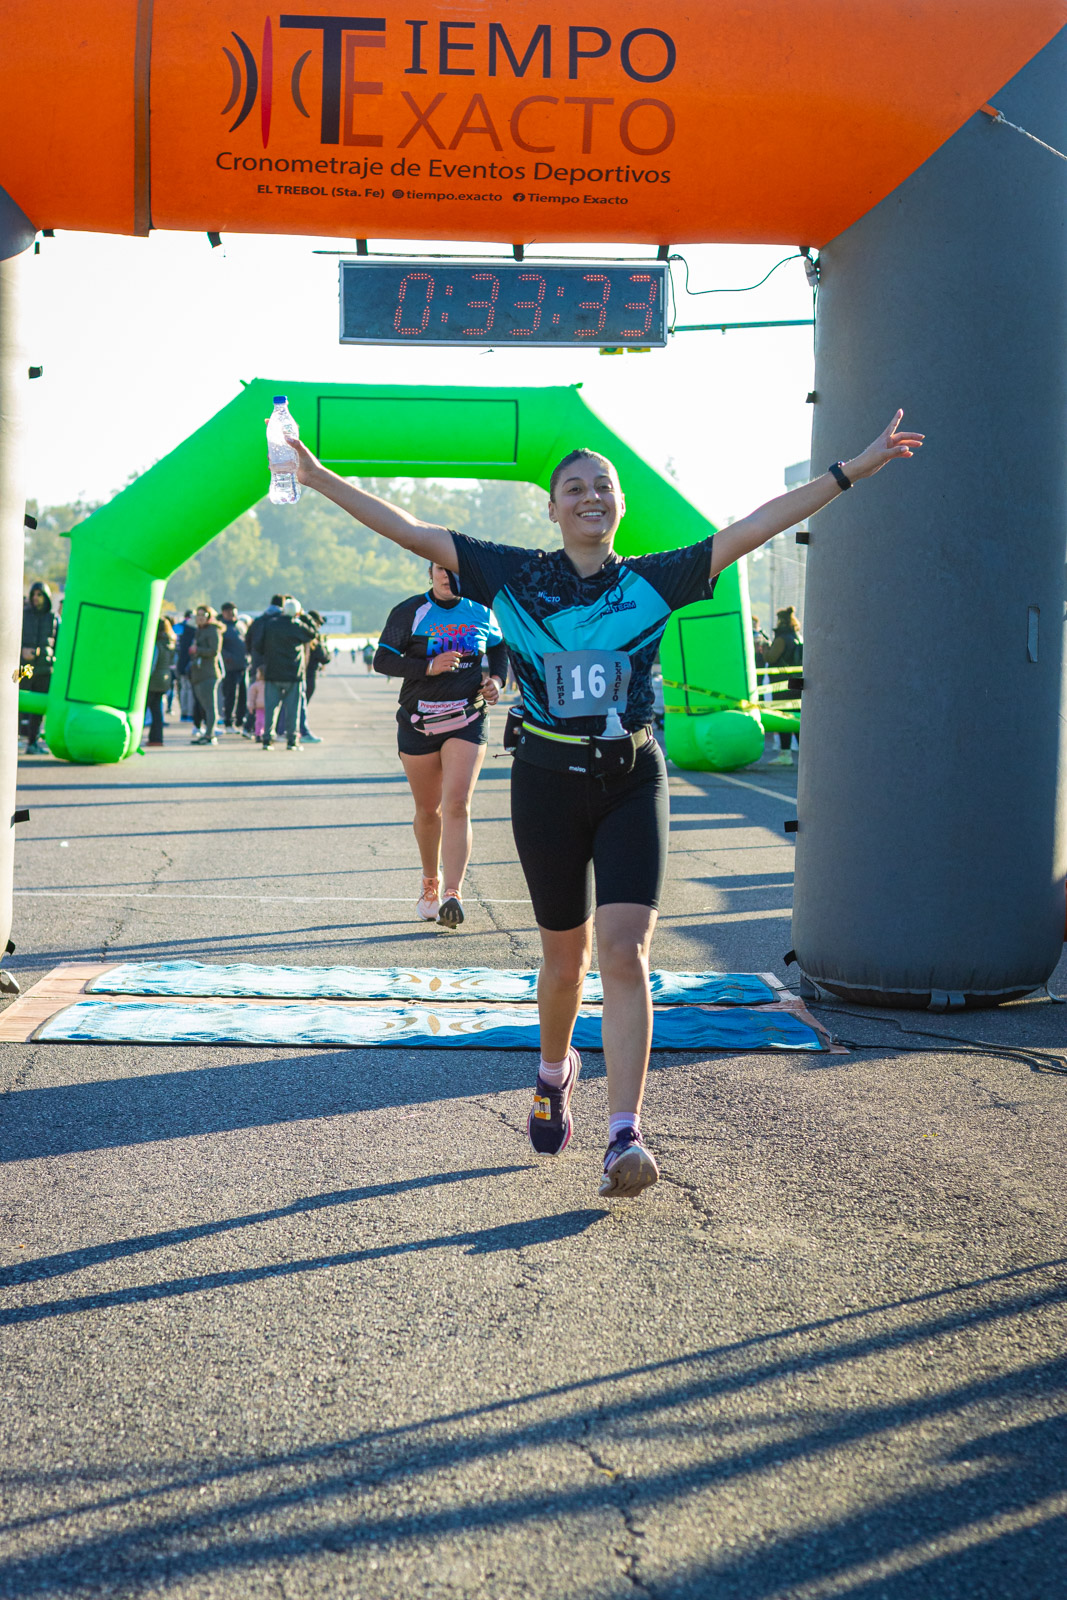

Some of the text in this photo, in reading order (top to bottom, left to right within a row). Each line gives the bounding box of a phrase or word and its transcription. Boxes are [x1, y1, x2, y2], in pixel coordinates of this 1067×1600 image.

[216, 152, 671, 185] Cronometraje de Eventos Deportivos
[257, 184, 385, 199] EL TREBOL (Sta. Fe)
[528, 193, 628, 205] Tiempo Exacto
[393, 273, 657, 337] 0:33:33
[555, 665, 565, 706] TIEMPO
[571, 663, 606, 700] 16
[612, 661, 622, 702] EXACTO
